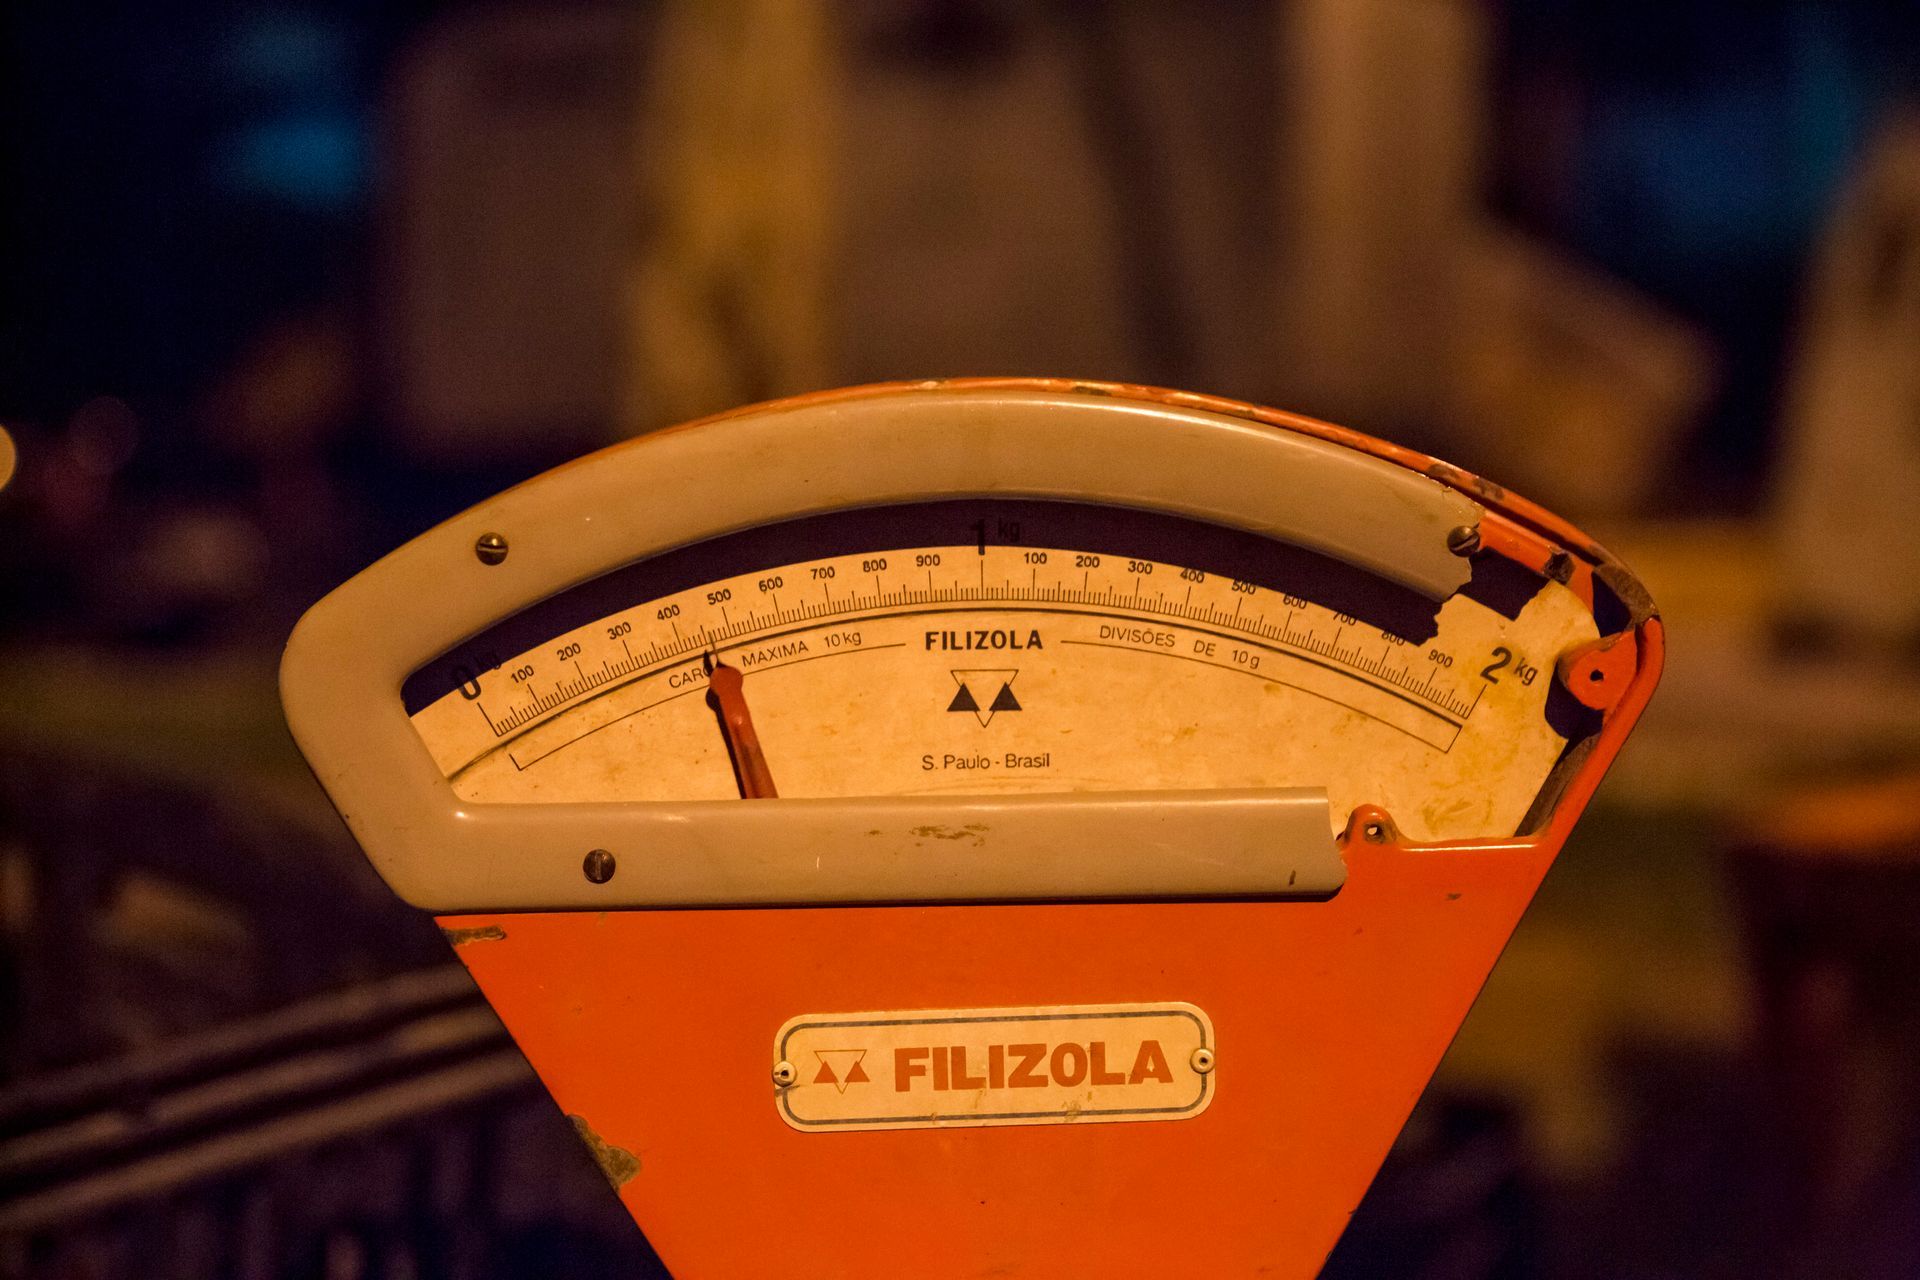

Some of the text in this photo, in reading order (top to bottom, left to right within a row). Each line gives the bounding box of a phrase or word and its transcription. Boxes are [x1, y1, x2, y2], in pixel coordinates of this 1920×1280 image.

[969, 519, 984, 556] 1
[863, 558, 887, 573] 800
[916, 553, 941, 568] 900
[1024, 551, 1047, 565] 100
[1075, 555, 1100, 569] 200
[1128, 560, 1153, 575] 300
[810, 565, 836, 581] 700
[1180, 567, 1205, 584] 400
[758, 576, 784, 593] 600
[1231, 576, 1257, 596] 500
[707, 588, 732, 606] 500
[1282, 591, 1308, 610] 600
[656, 604, 681, 622] 400
[607, 622, 632, 641] 300
[925, 630, 1043, 650] FILIZOLA
[1099, 625, 1176, 648] DIVISÕES
[1193, 639, 1216, 657] DE
[556, 643, 582, 662] 200
[742, 640, 809, 668] MAXIMA
[1428, 649, 1453, 668] 900
[510, 665, 535, 685] 100
[1480, 646, 1538, 686] 2 kg
[922, 755, 939, 771] S.
[944, 755, 990, 770] Paulo
[1005, 753, 1051, 768] Brasil
[894, 1040, 1174, 1092] FILIZOLA
